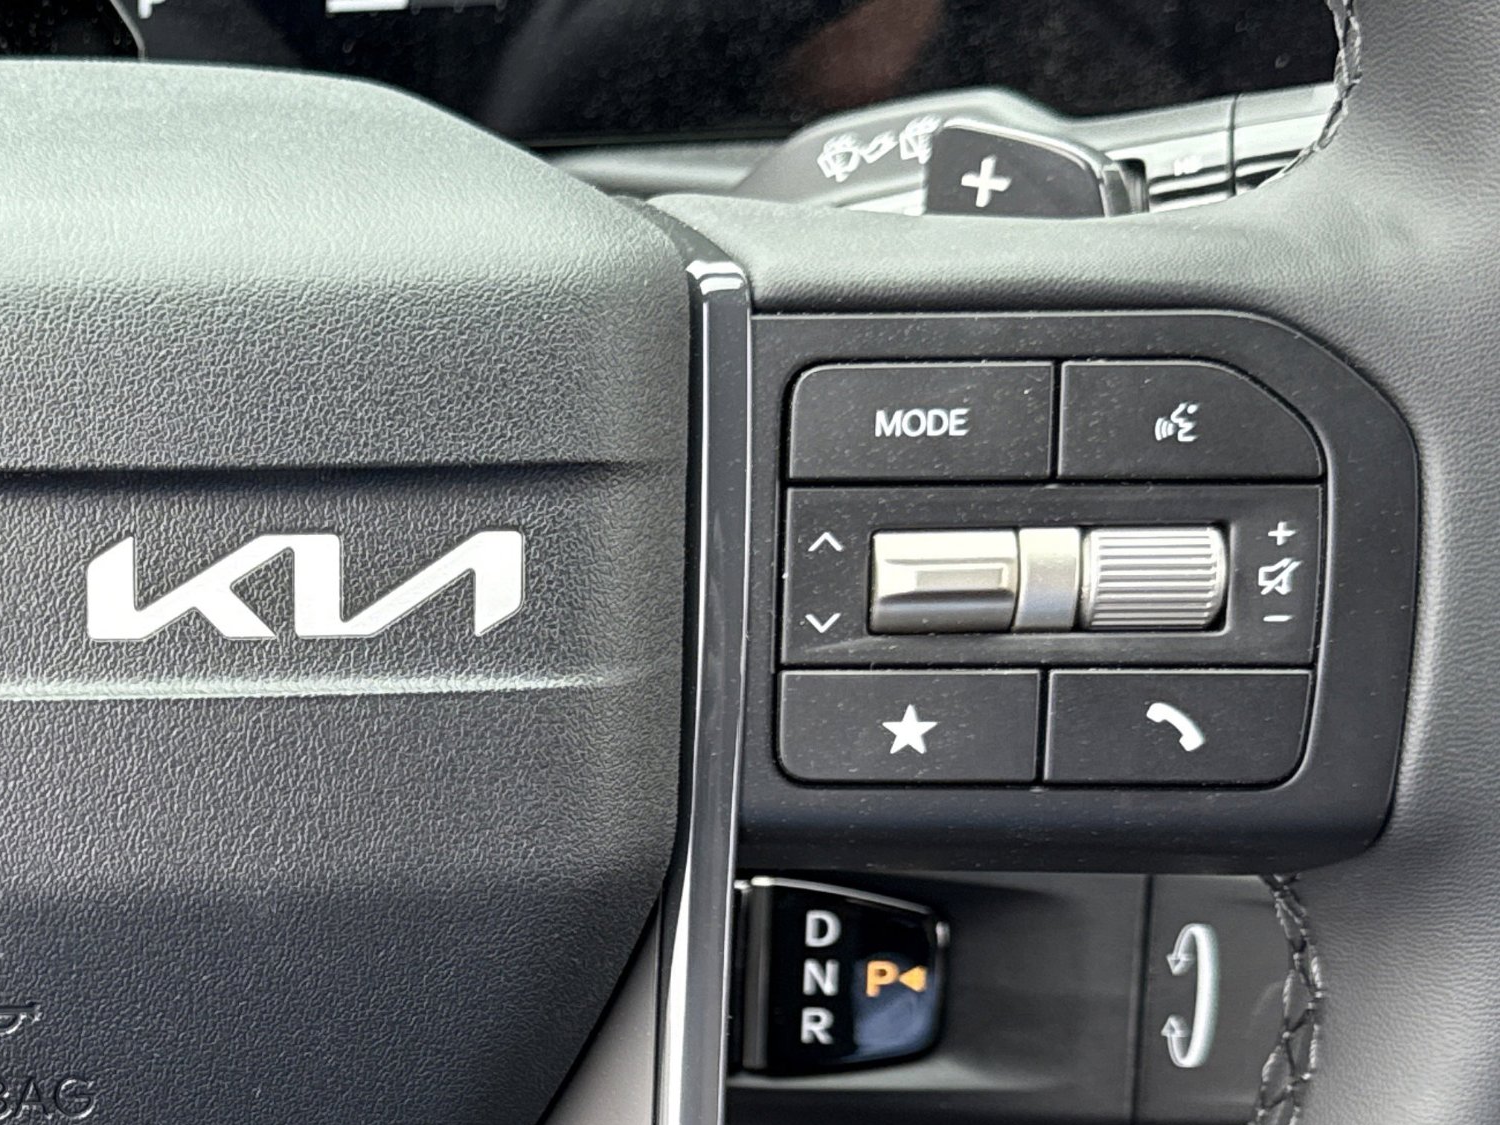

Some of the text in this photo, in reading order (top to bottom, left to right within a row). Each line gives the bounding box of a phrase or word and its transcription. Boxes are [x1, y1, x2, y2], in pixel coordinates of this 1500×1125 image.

[874, 407, 971, 438] MODE
[86, 530, 524, 642] KIA
[805, 909, 842, 948] D
[802, 957, 840, 997] N
[866, 959, 899, 998] P
[800, 1006, 834, 1045] R
